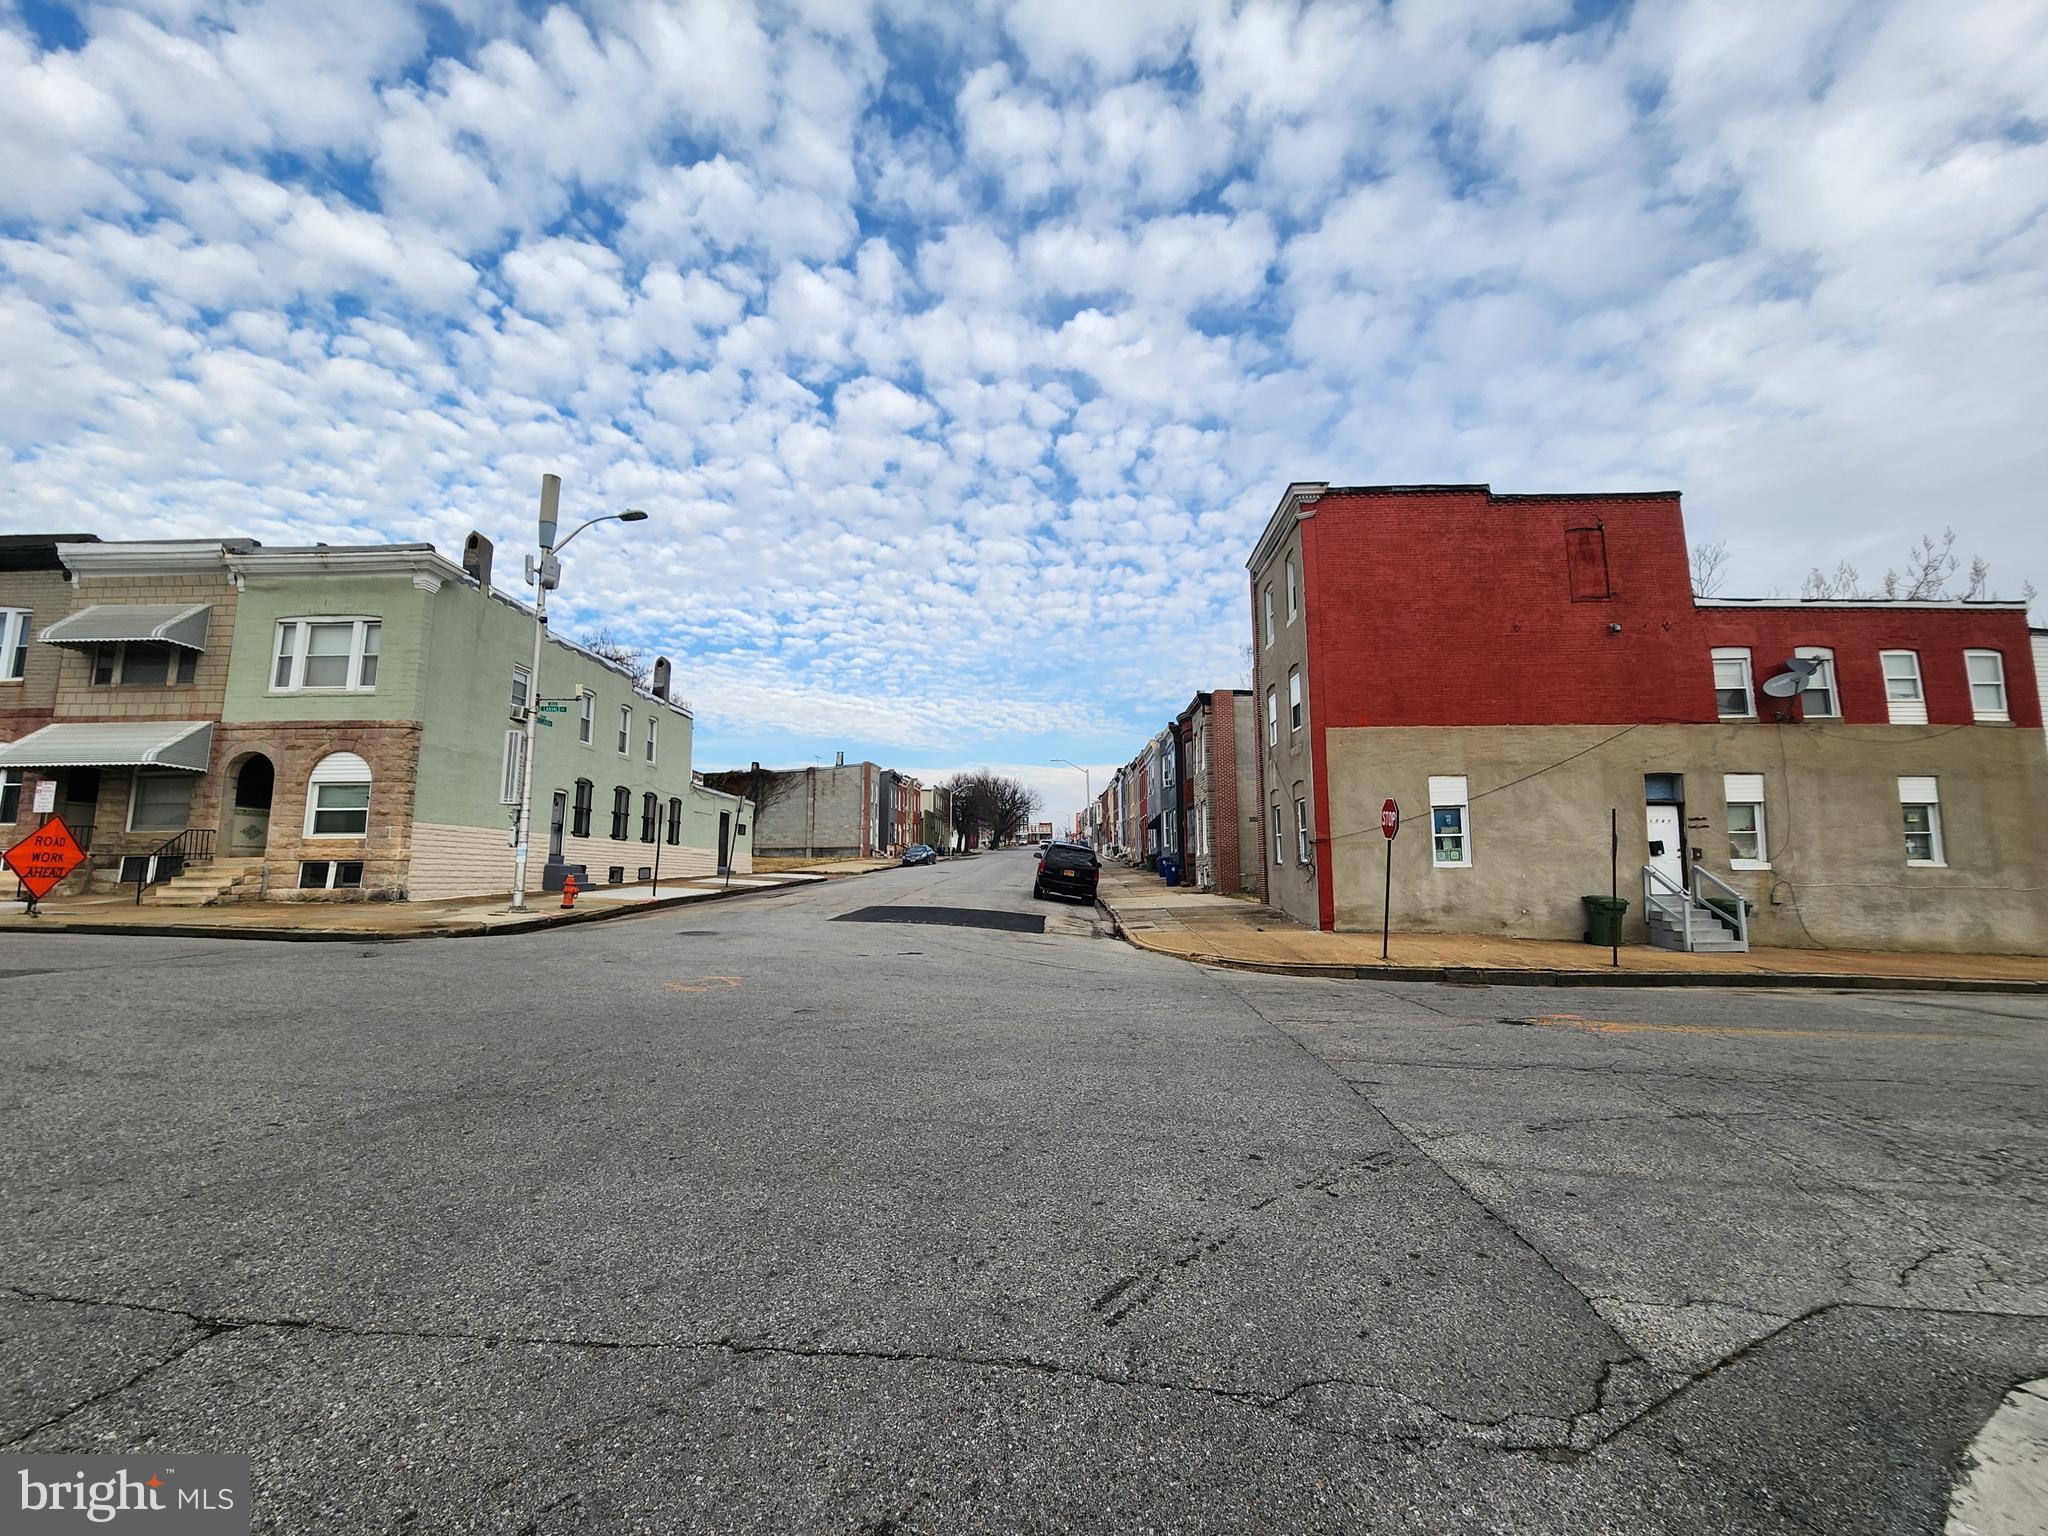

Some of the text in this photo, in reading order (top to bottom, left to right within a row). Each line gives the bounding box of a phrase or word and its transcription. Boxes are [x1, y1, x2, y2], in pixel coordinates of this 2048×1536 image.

[1382, 810, 1396, 827] STOP
[35, 835, 66, 847] ROAD
[31, 852, 64, 863] WORK
[26, 866, 64, 878] AHEAD
